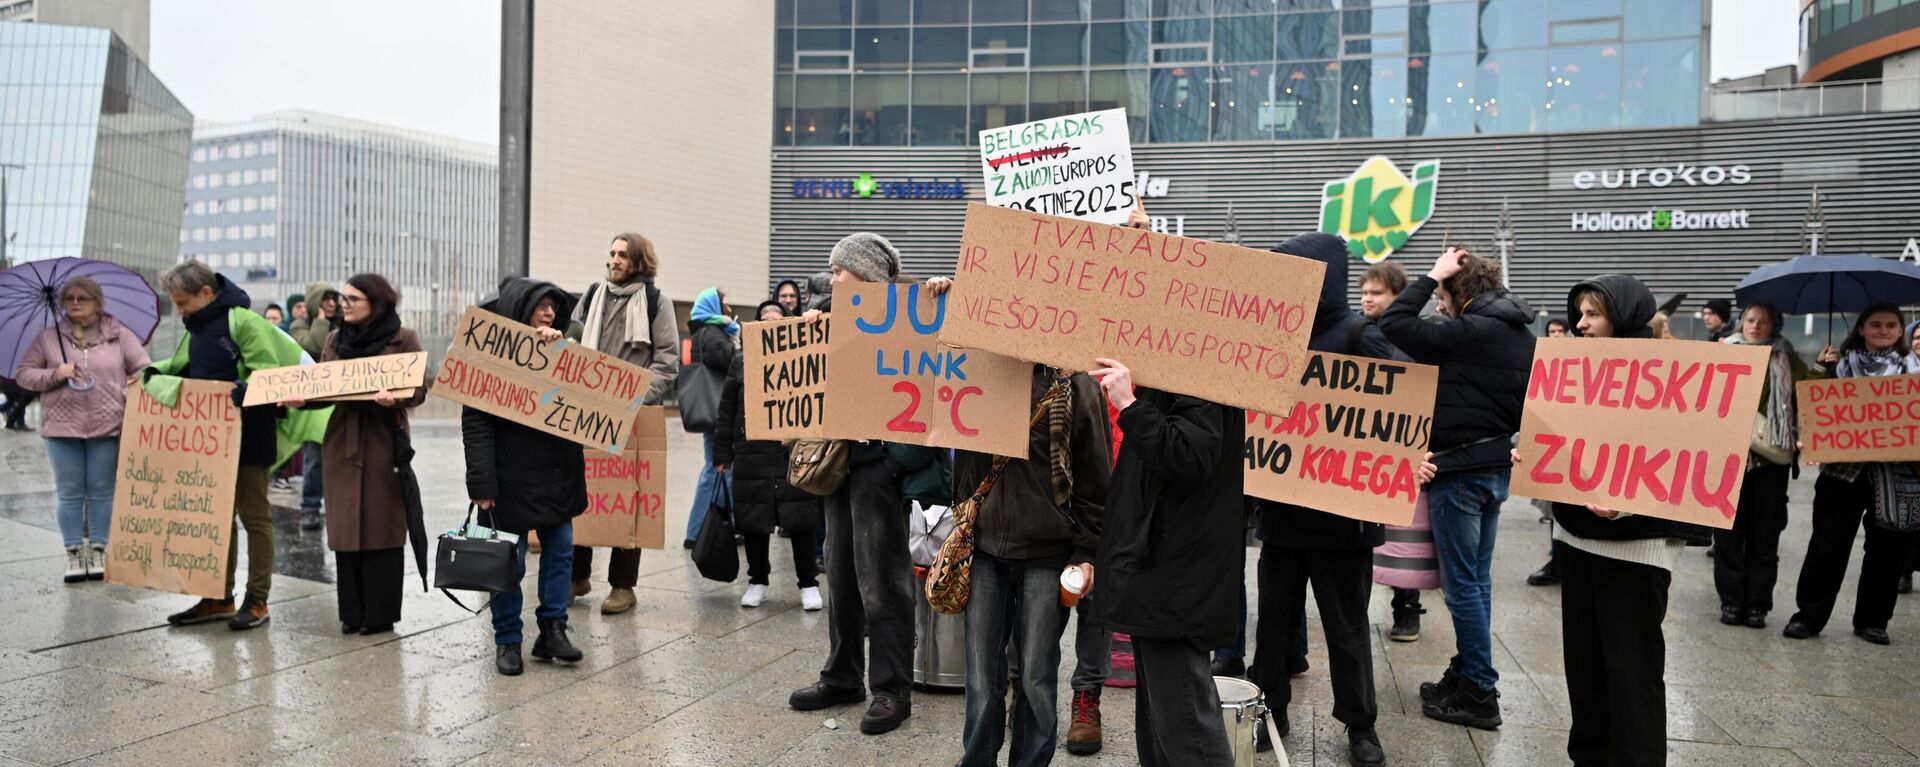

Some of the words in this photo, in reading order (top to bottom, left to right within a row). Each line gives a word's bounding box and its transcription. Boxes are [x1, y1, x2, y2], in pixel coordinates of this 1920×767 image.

[984, 115, 1104, 154] BELGRADAS
[1031, 217, 1208, 268] TVARAUS
[963, 246, 989, 273] IR
[1014, 251, 1148, 299] VISIEMS
[1164, 278, 1306, 334] PRIEINAMO
[464, 316, 549, 371] KAINOS
[552, 349, 641, 401] AUKŠTYN
[877, 350, 968, 381] LINK
[963, 295, 1078, 335] VIEŠOJO
[1100, 318, 1291, 380] TRANSPORTO
[438, 357, 539, 416] SOLIDARUMAS
[544, 396, 623, 446] ŽEMYN
[1301, 354, 1407, 395] AID.LT
[1527, 356, 1752, 418] NEVEISKIT
[1810, 381, 1858, 402] DAR
[1325, 403, 1431, 450] VILNIUS
[130, 485, 156, 510] turi
[1300, 443, 1417, 504] KOLEGA
[1531, 433, 1741, 519] ZUIKIŲ
